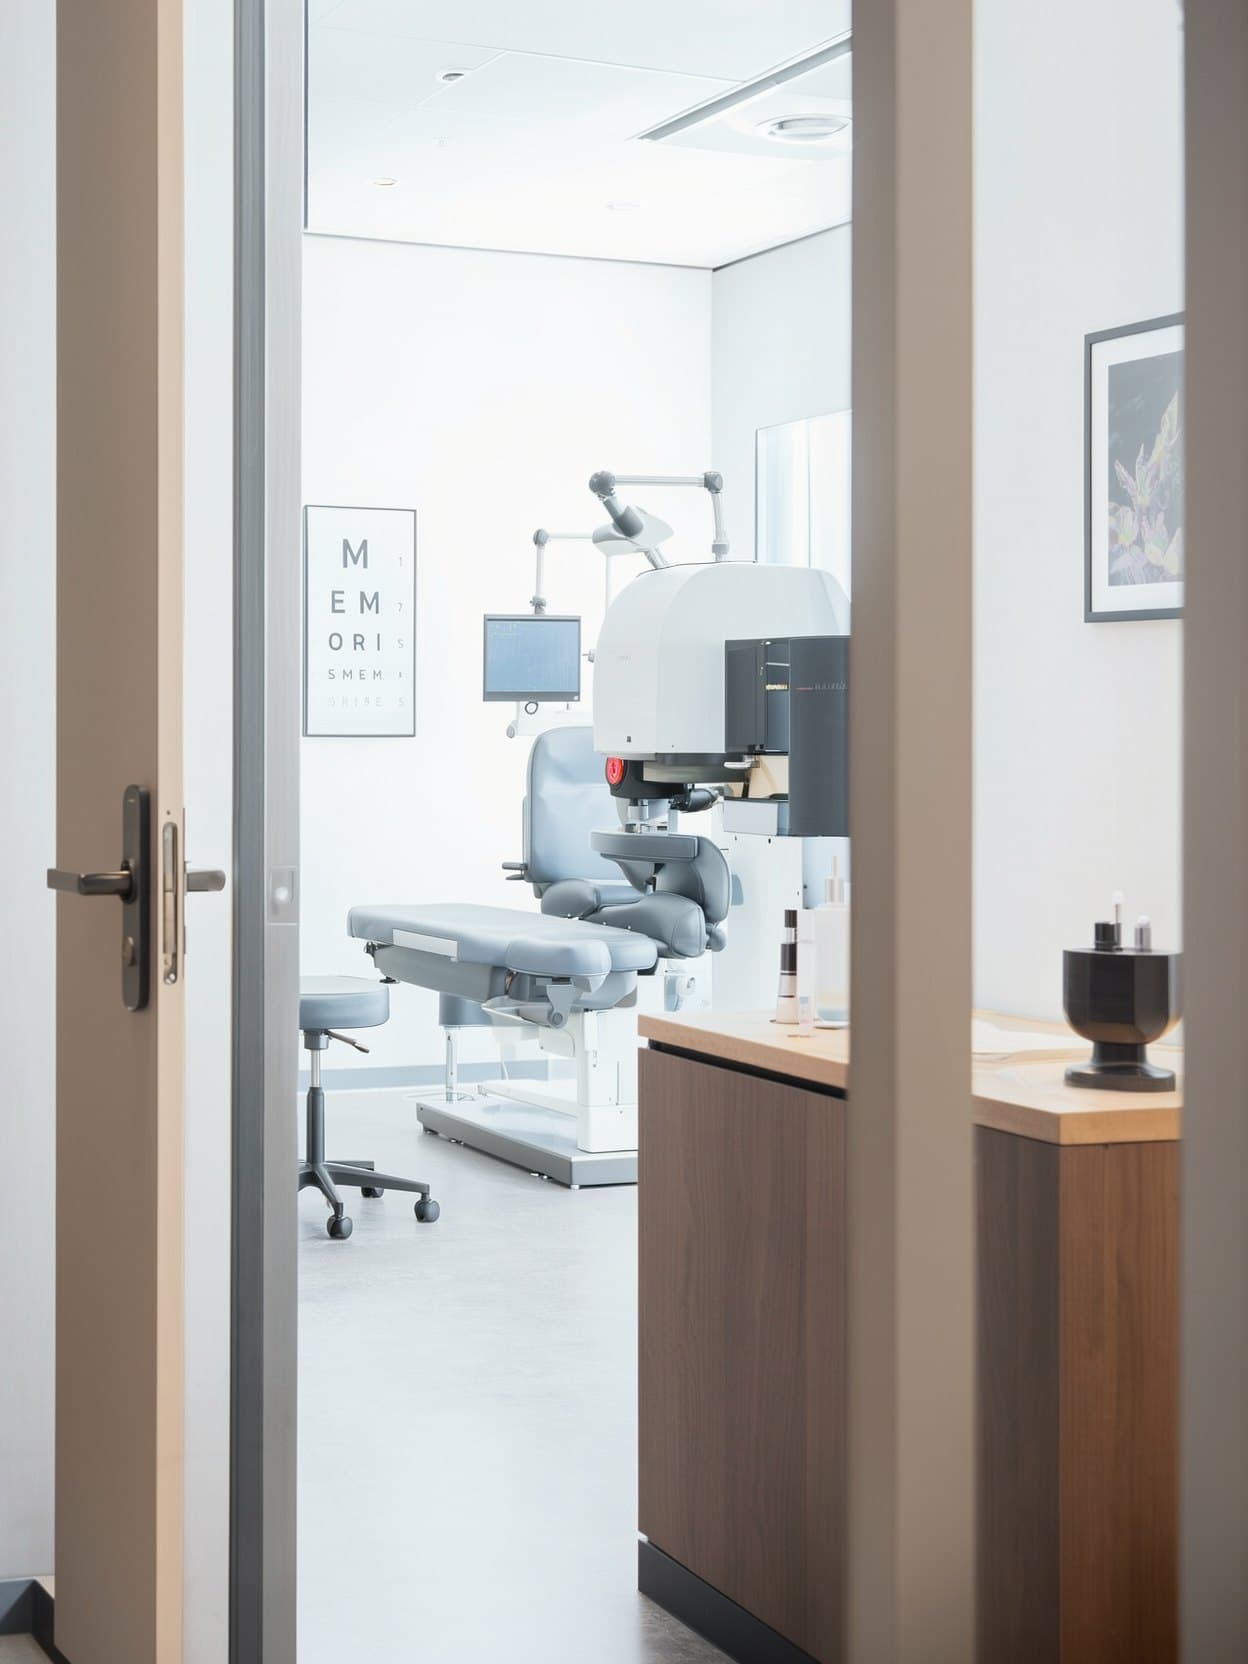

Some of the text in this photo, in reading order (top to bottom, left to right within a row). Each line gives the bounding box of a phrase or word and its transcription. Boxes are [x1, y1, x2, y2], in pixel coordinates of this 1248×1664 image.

[342, 538, 369, 569] M
[328, 632, 381, 651] ORI
[328, 669, 383, 681] SMEM
